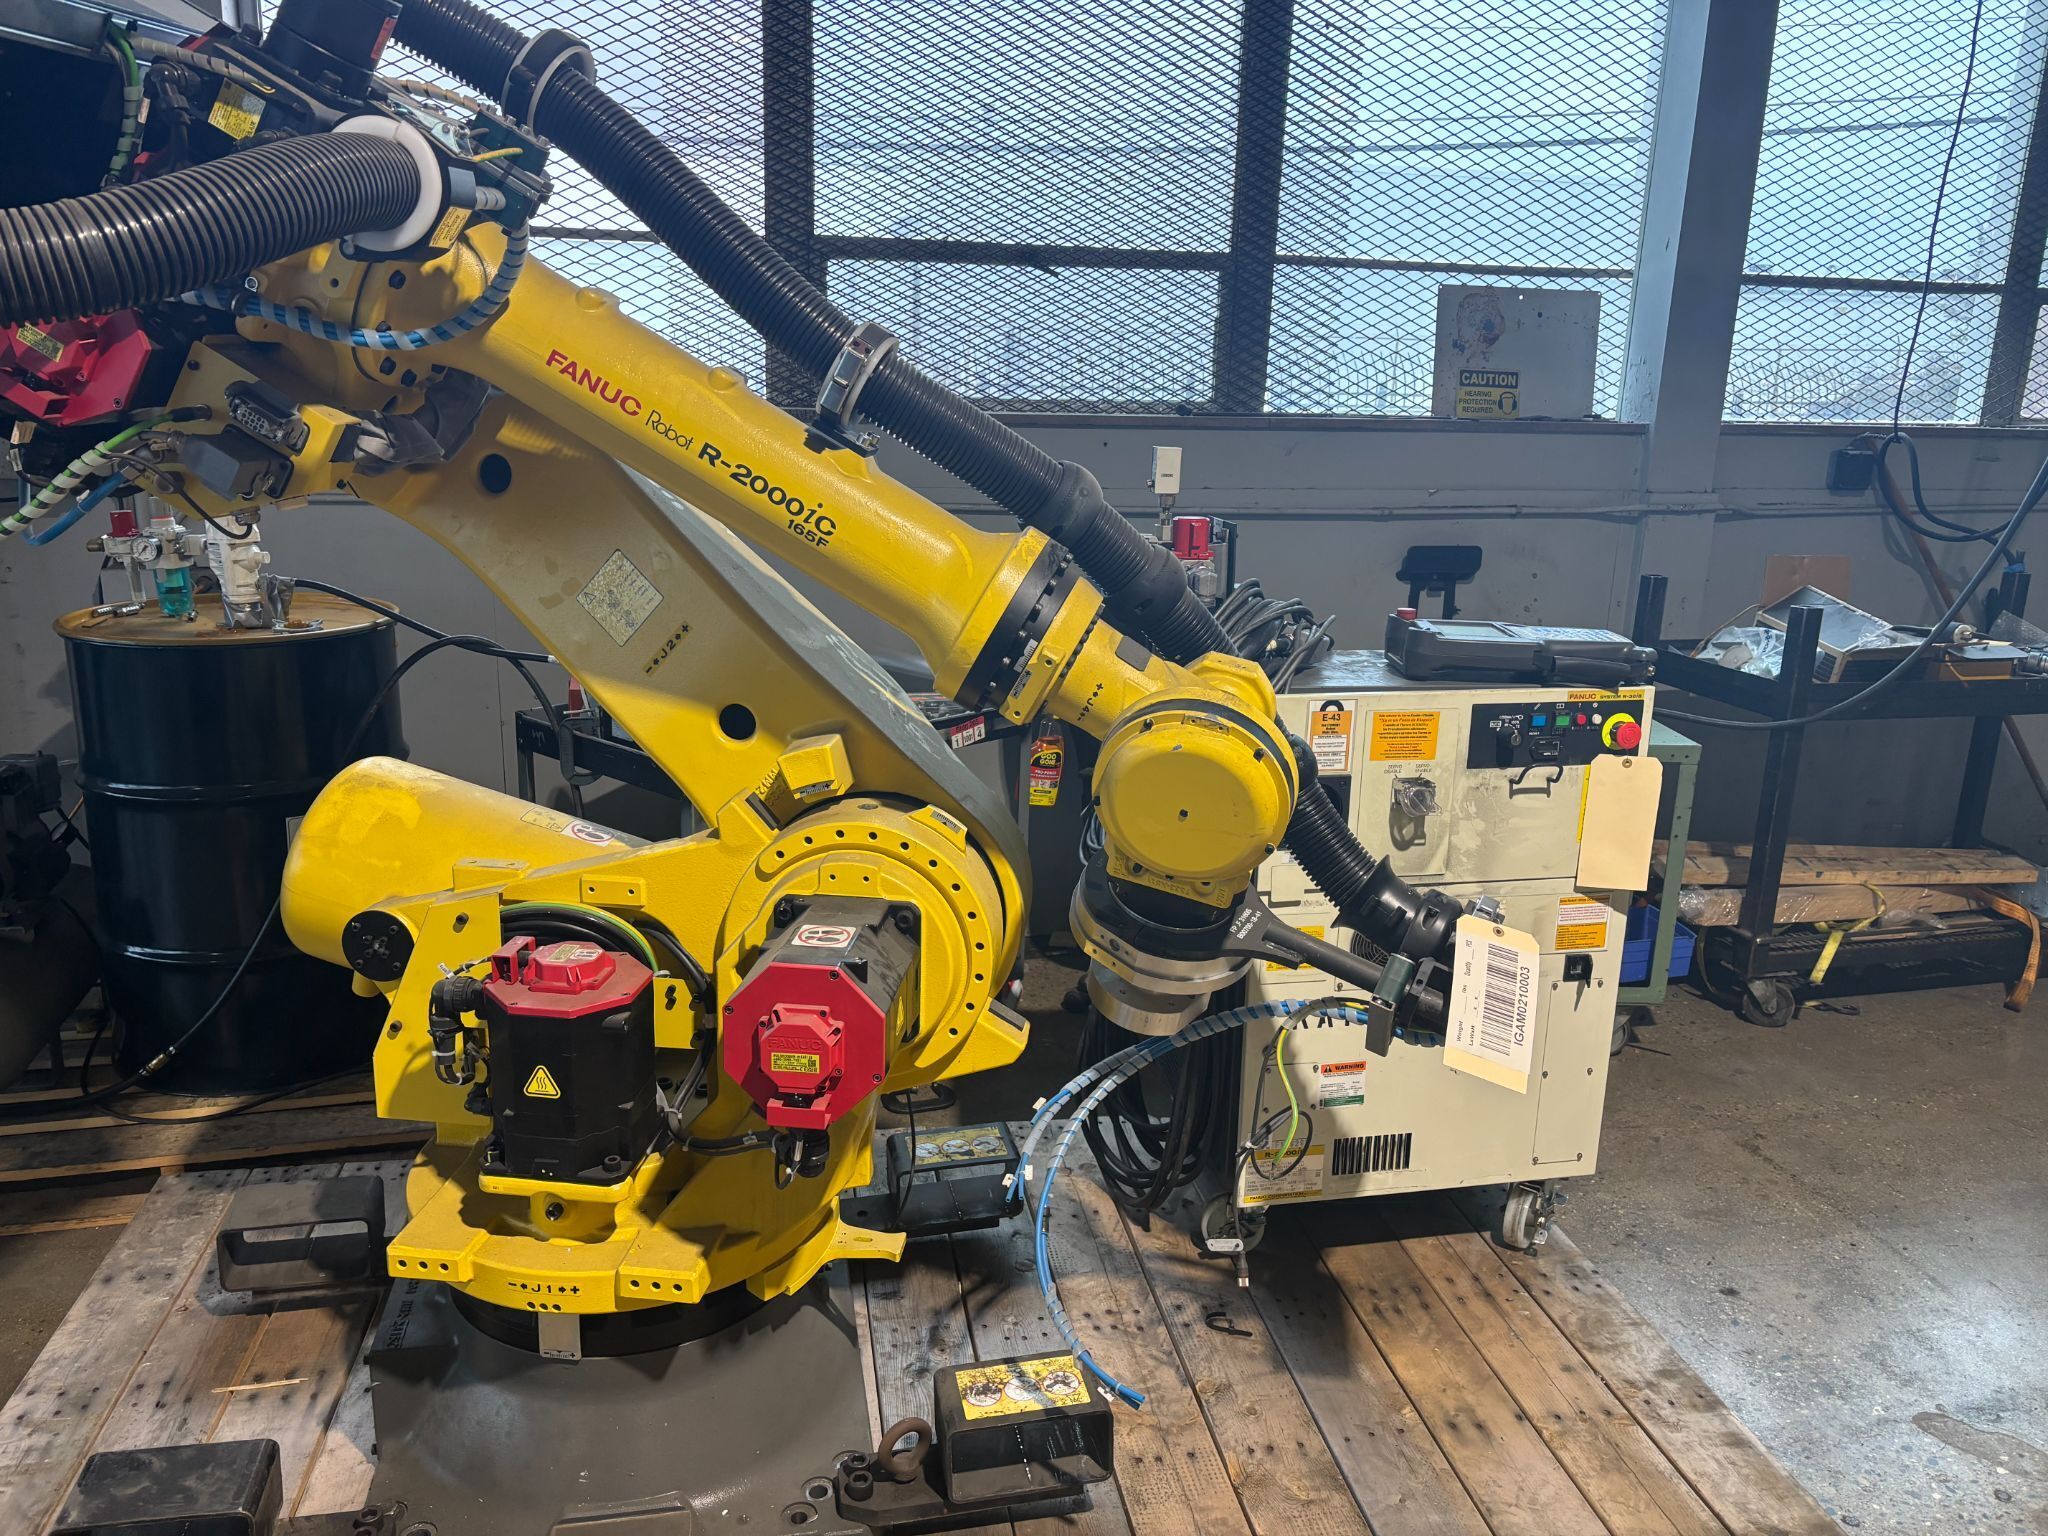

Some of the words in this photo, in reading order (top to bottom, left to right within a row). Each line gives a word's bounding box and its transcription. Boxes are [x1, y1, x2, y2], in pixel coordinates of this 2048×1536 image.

[1461, 372, 1516, 386] CAUTION
[1464, 390, 1492, 398] HEARING
[1458, 398, 1497, 406] PROTECTION
[1462, 406, 1493, 414] REQUIRED
[545, 349, 643, 418] FANUC
[645, 409, 694, 451] Robot
[698, 442, 837, 537] R-2000iC
[787, 519, 830, 548] 165F
[1322, 713, 1341, 722] E-43
[1513, 966, 1530, 1047] IGAM0210003
[768, 1038, 821, 1051] FANUC
[1335, 1063, 1365, 1071] WARNING
[531, 1283, 552, 1294] J1
